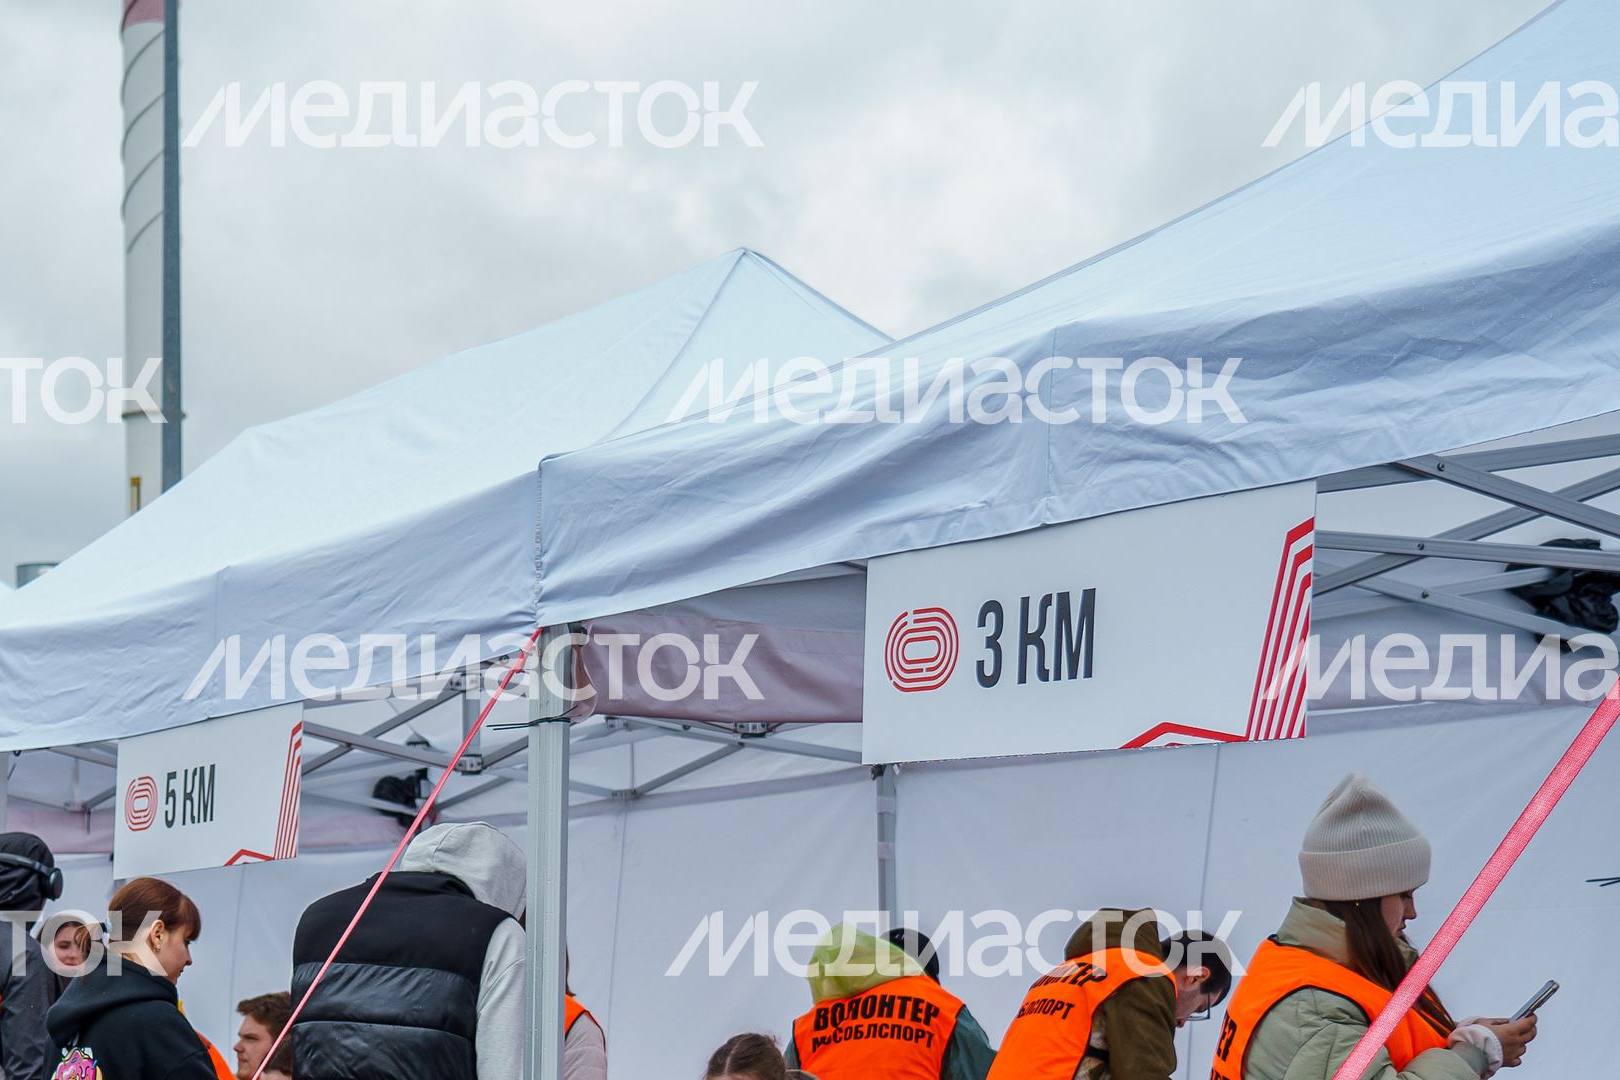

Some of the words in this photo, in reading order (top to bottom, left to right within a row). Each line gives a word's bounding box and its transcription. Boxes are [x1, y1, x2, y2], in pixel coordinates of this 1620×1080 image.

[975, 600, 1004, 689] 3
[1016, 587, 1096, 686] КМ
[164, 770, 177, 828] 5
[181, 763, 216, 826] КМ
[814, 994, 940, 1031] ВОЛОНТЕР
